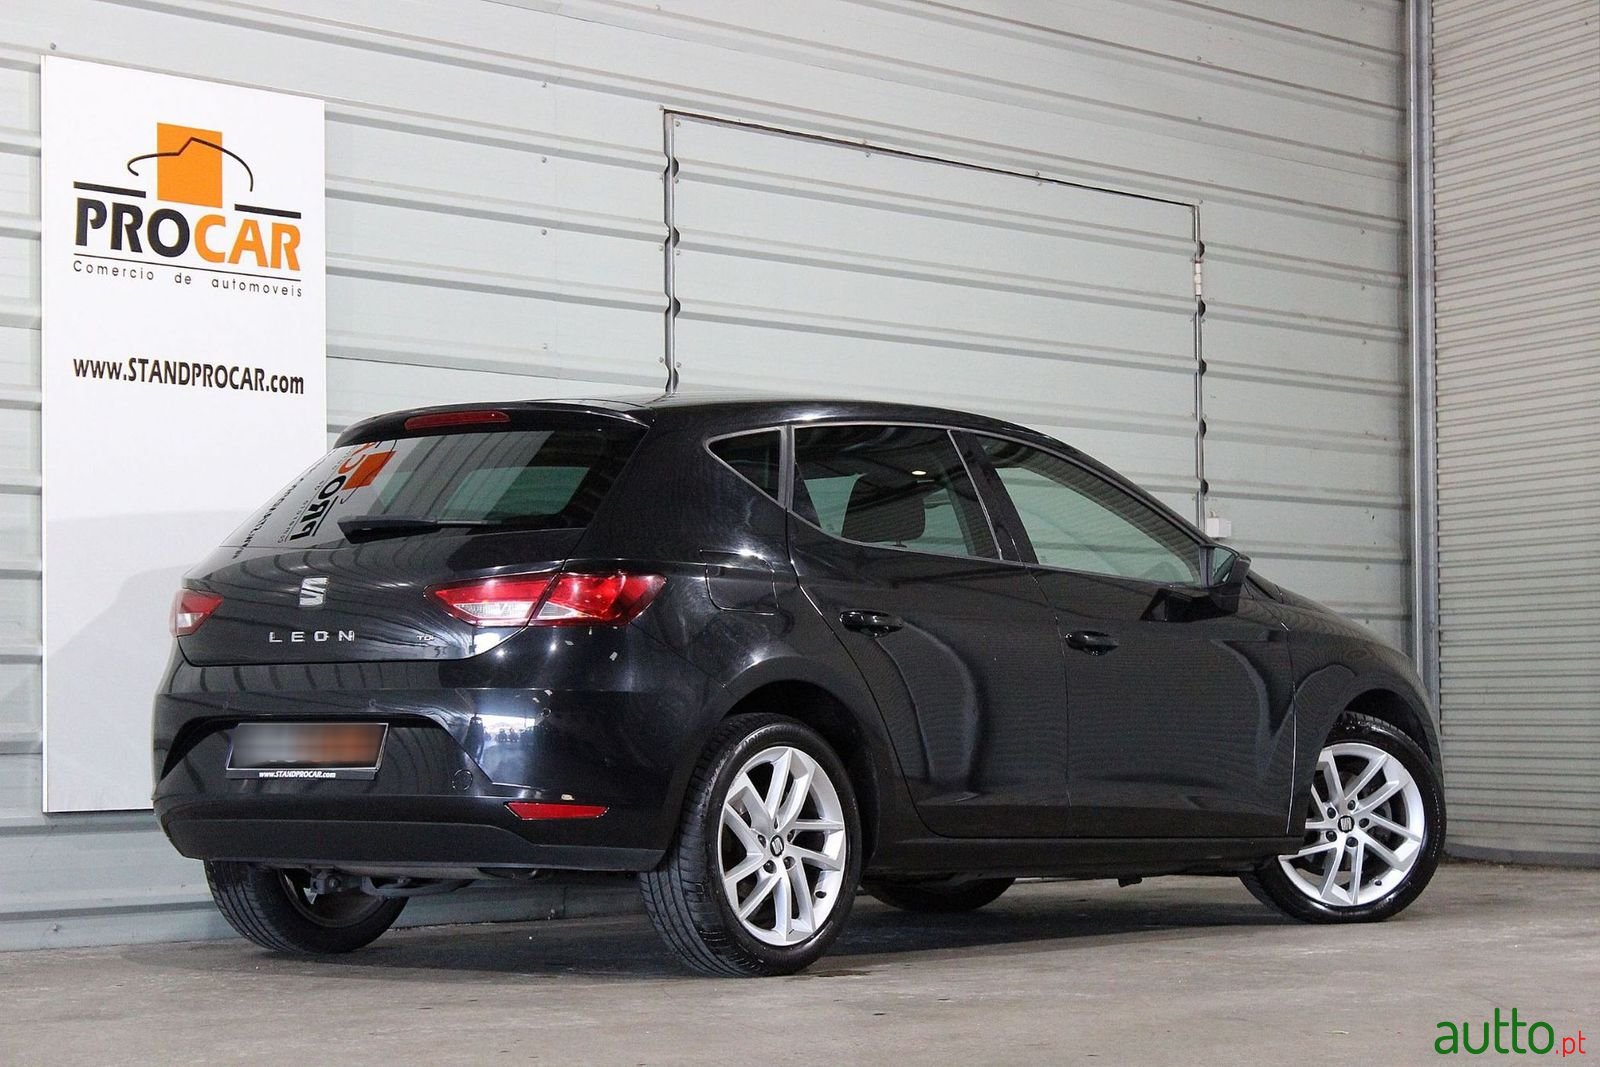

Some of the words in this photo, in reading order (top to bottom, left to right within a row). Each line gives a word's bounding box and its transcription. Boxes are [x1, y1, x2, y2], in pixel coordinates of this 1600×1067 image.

[75, 197, 301, 271] PROCAR
[73, 260, 154, 281] Comercio
[174, 272, 192, 285] de
[211, 278, 302, 298] automoveis
[73, 357, 304, 394] www.STANDPROCAR.com
[268, 630, 355, 643] LEON
[258, 770, 337, 779] www.STANDPROCAR.com
